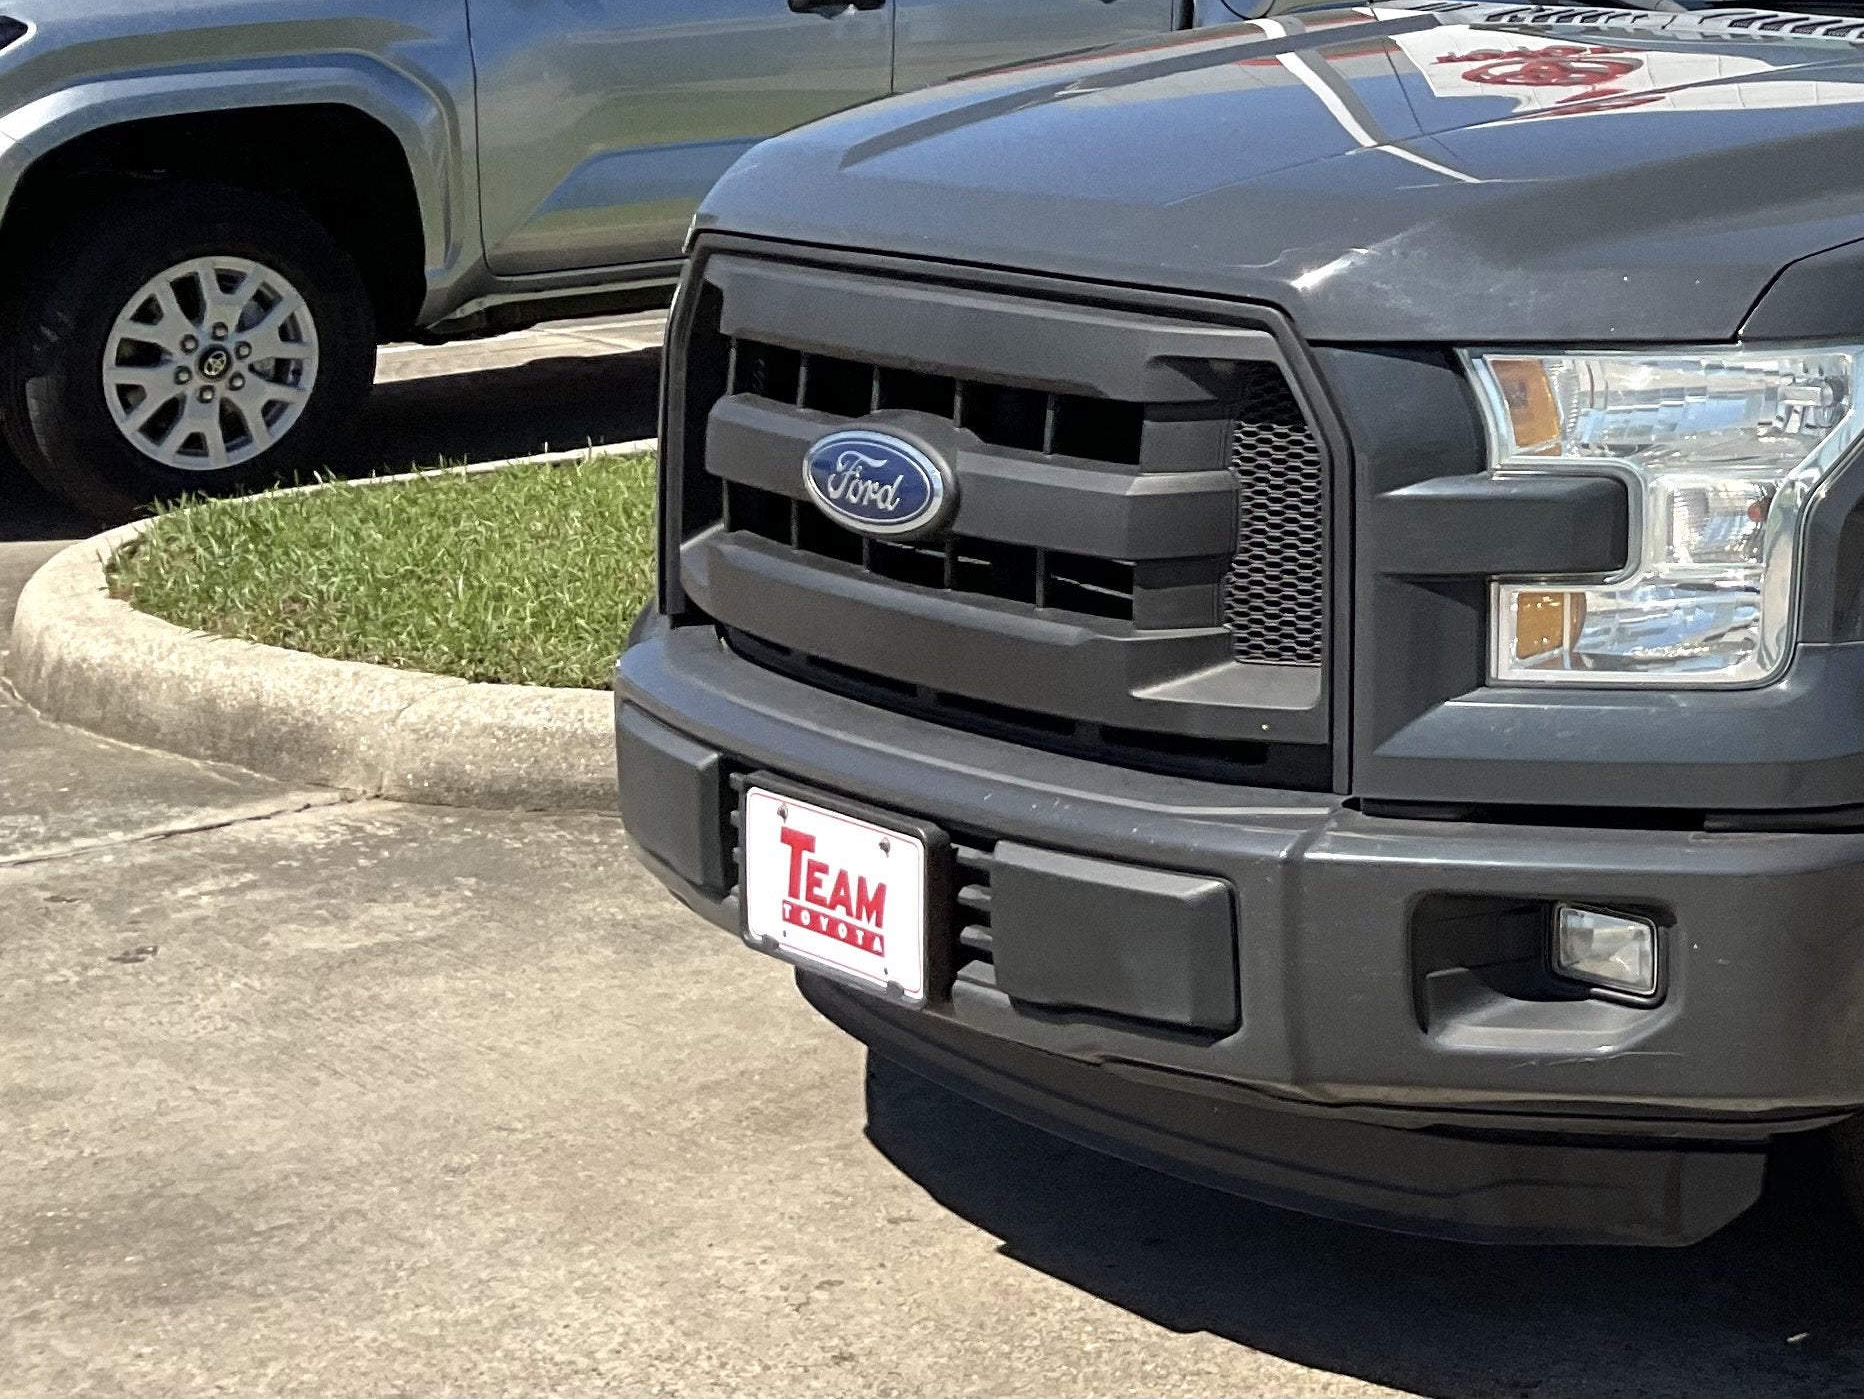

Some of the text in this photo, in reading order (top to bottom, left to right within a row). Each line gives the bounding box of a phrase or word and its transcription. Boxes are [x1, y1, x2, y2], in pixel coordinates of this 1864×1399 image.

[827, 450, 904, 511] Ford
[780, 826, 888, 929] TEAM
[782, 902, 884, 953] TOYOTA
